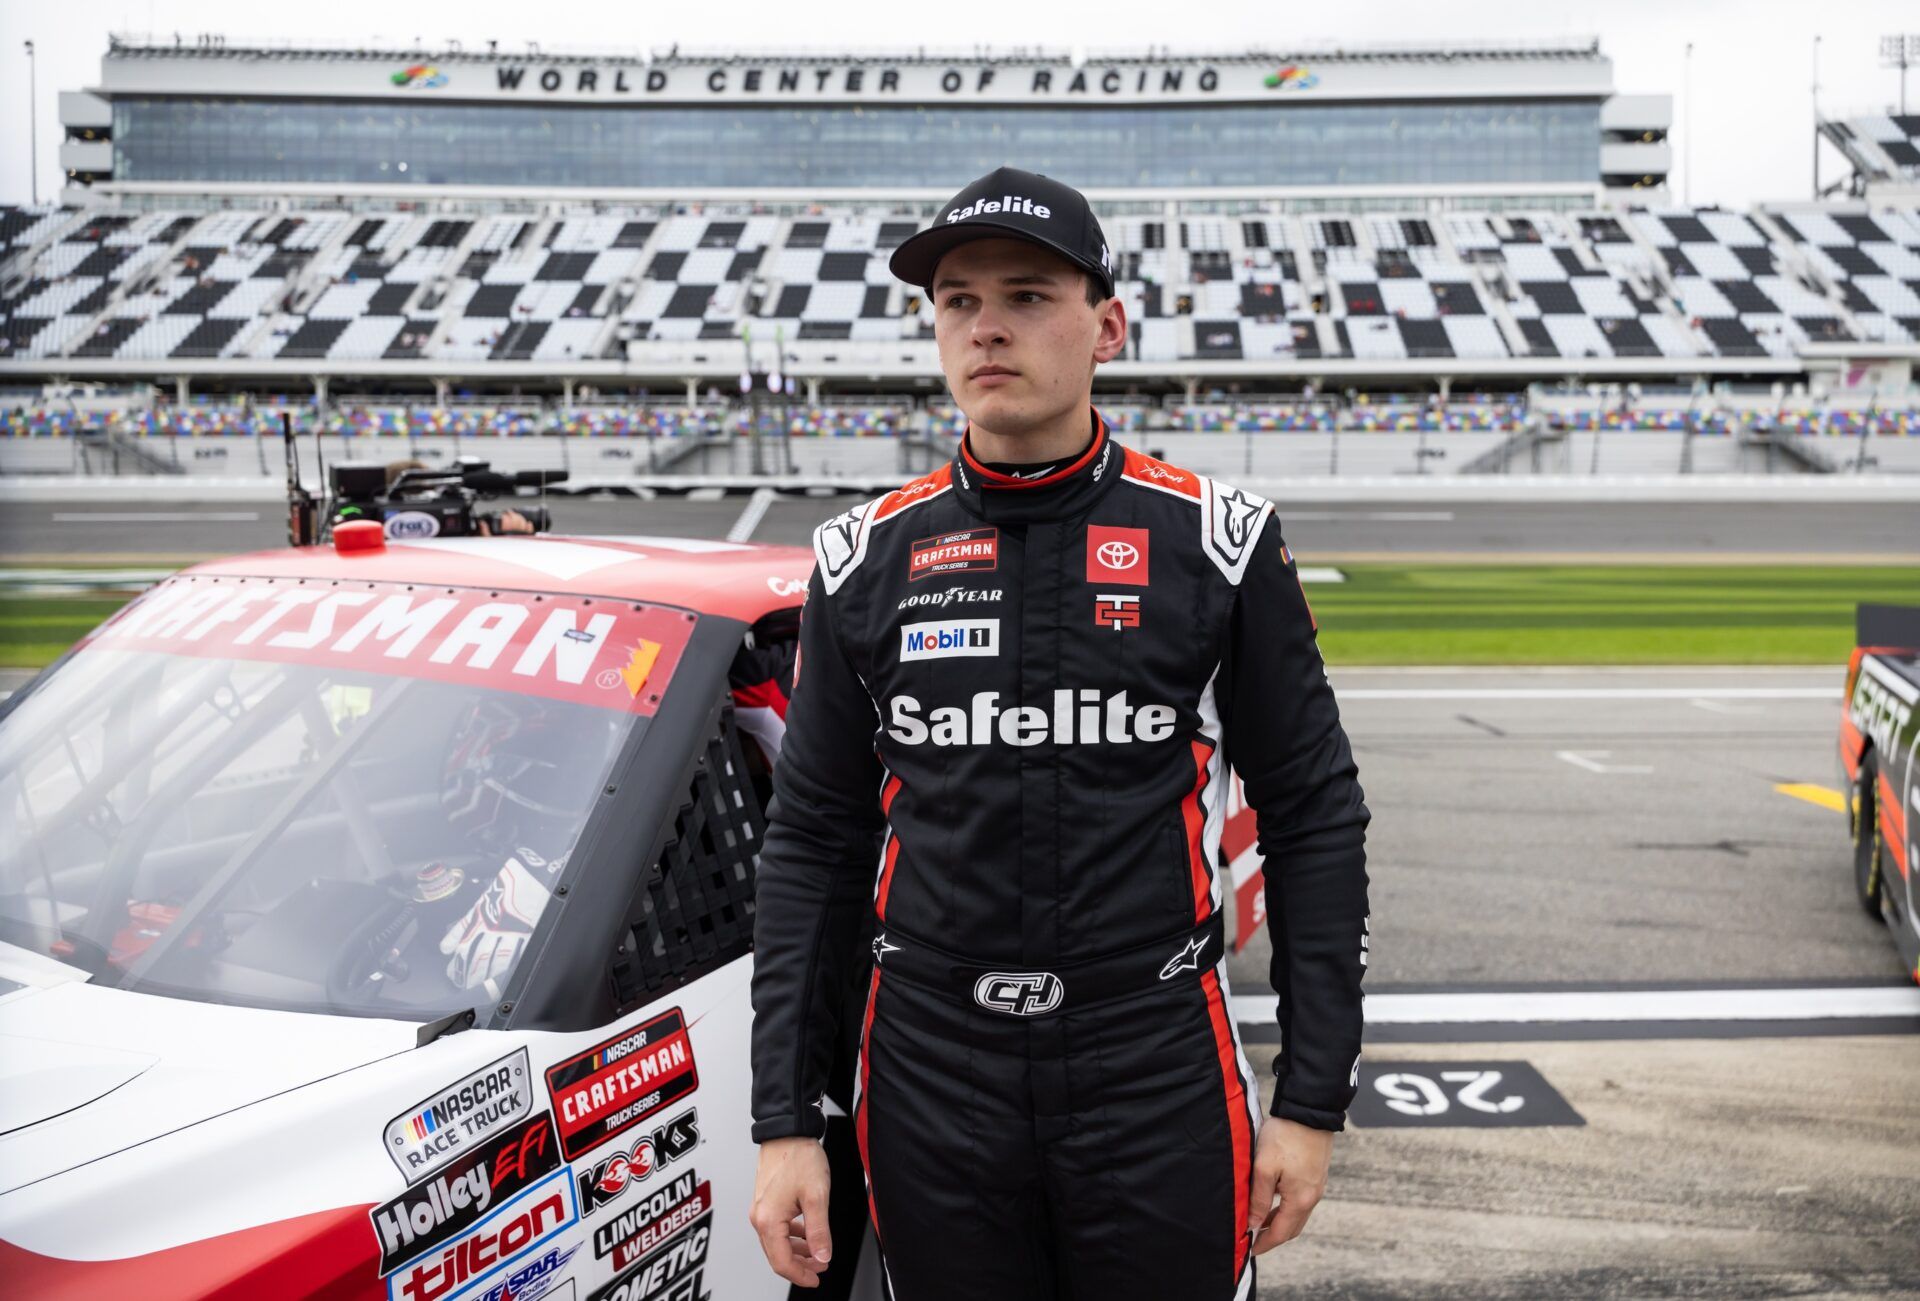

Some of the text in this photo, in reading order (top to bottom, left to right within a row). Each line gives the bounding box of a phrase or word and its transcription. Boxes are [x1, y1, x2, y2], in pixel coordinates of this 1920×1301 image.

[498, 69, 1220, 93] WORLD CENTER OF RACING
[946, 195, 1051, 225] Safelite
[914, 543, 993, 566] CRAFTSMAN
[943, 533, 972, 544] NASCAR
[931, 561, 969, 572] TRUCK SERIES
[907, 628, 965, 652] Mobil
[887, 688, 1177, 747] Safelite
[606, 1030, 648, 1063] NASCAR
[431, 1066, 512, 1129] NASCAR
[562, 1040, 686, 1123] CRAFTSMAN
[1374, 1070, 1525, 1116] 26
[406, 1090, 522, 1169] RACE TRUCK
[605, 1090, 661, 1131] TRUCK SERIES
[577, 1107, 699, 1218] KOOKS
[377, 1161, 493, 1256] Holley
[599, 1174, 693, 1254] LINCOLN
[622, 1196, 703, 1262] WELDERS
[402, 1193, 565, 1301] tilton
[508, 1249, 560, 1288] STAR
[600, 1226, 709, 1301] OMETIC
[518, 1276, 552, 1301] Bodies
